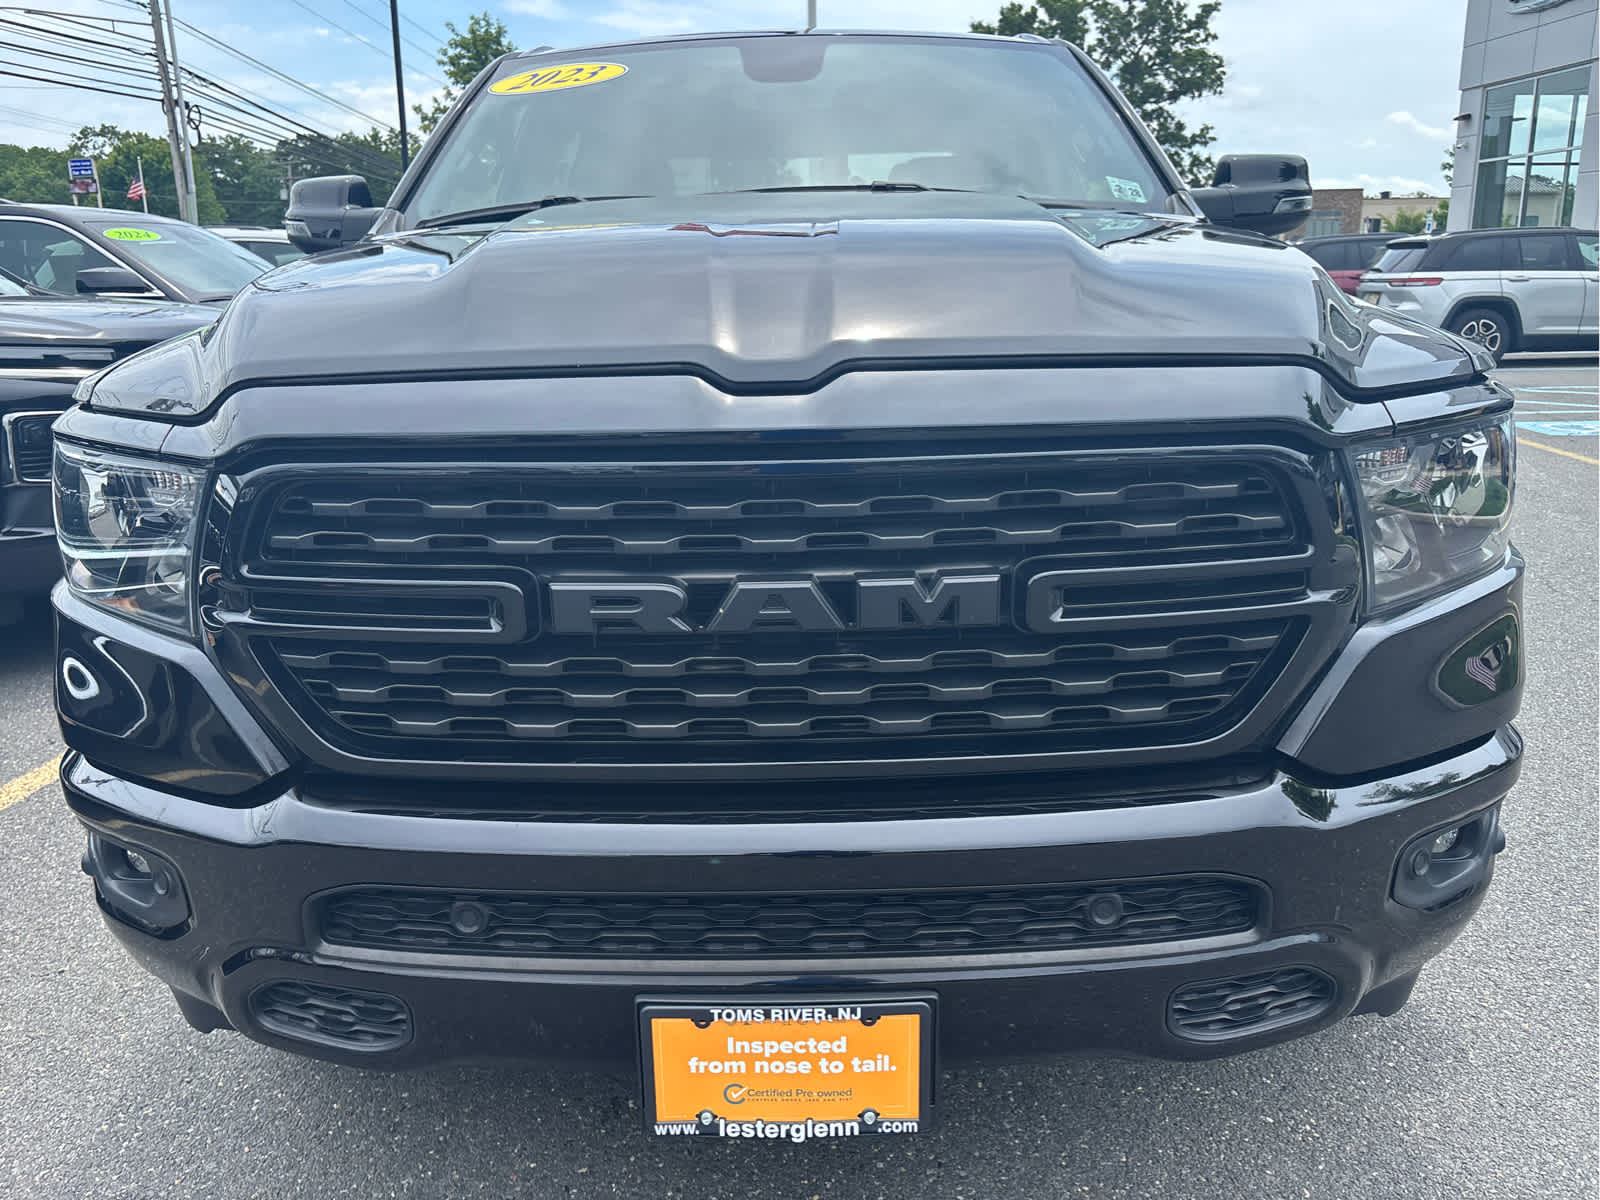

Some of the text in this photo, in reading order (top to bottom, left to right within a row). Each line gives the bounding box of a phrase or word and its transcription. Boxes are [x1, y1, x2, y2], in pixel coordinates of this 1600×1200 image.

[505, 65, 608, 91] 2023
[115, 230, 152, 240] 2024
[549, 571, 1002, 634] RAM
[710, 1007, 862, 1023] TOMS RIVER, NJ
[727, 1036, 847, 1058] Inspected
[688, 1055, 897, 1074] from nose to tail.
[747, 1088, 793, 1097] Certified
[654, 1118, 918, 1142] www. lesterglenn .com
